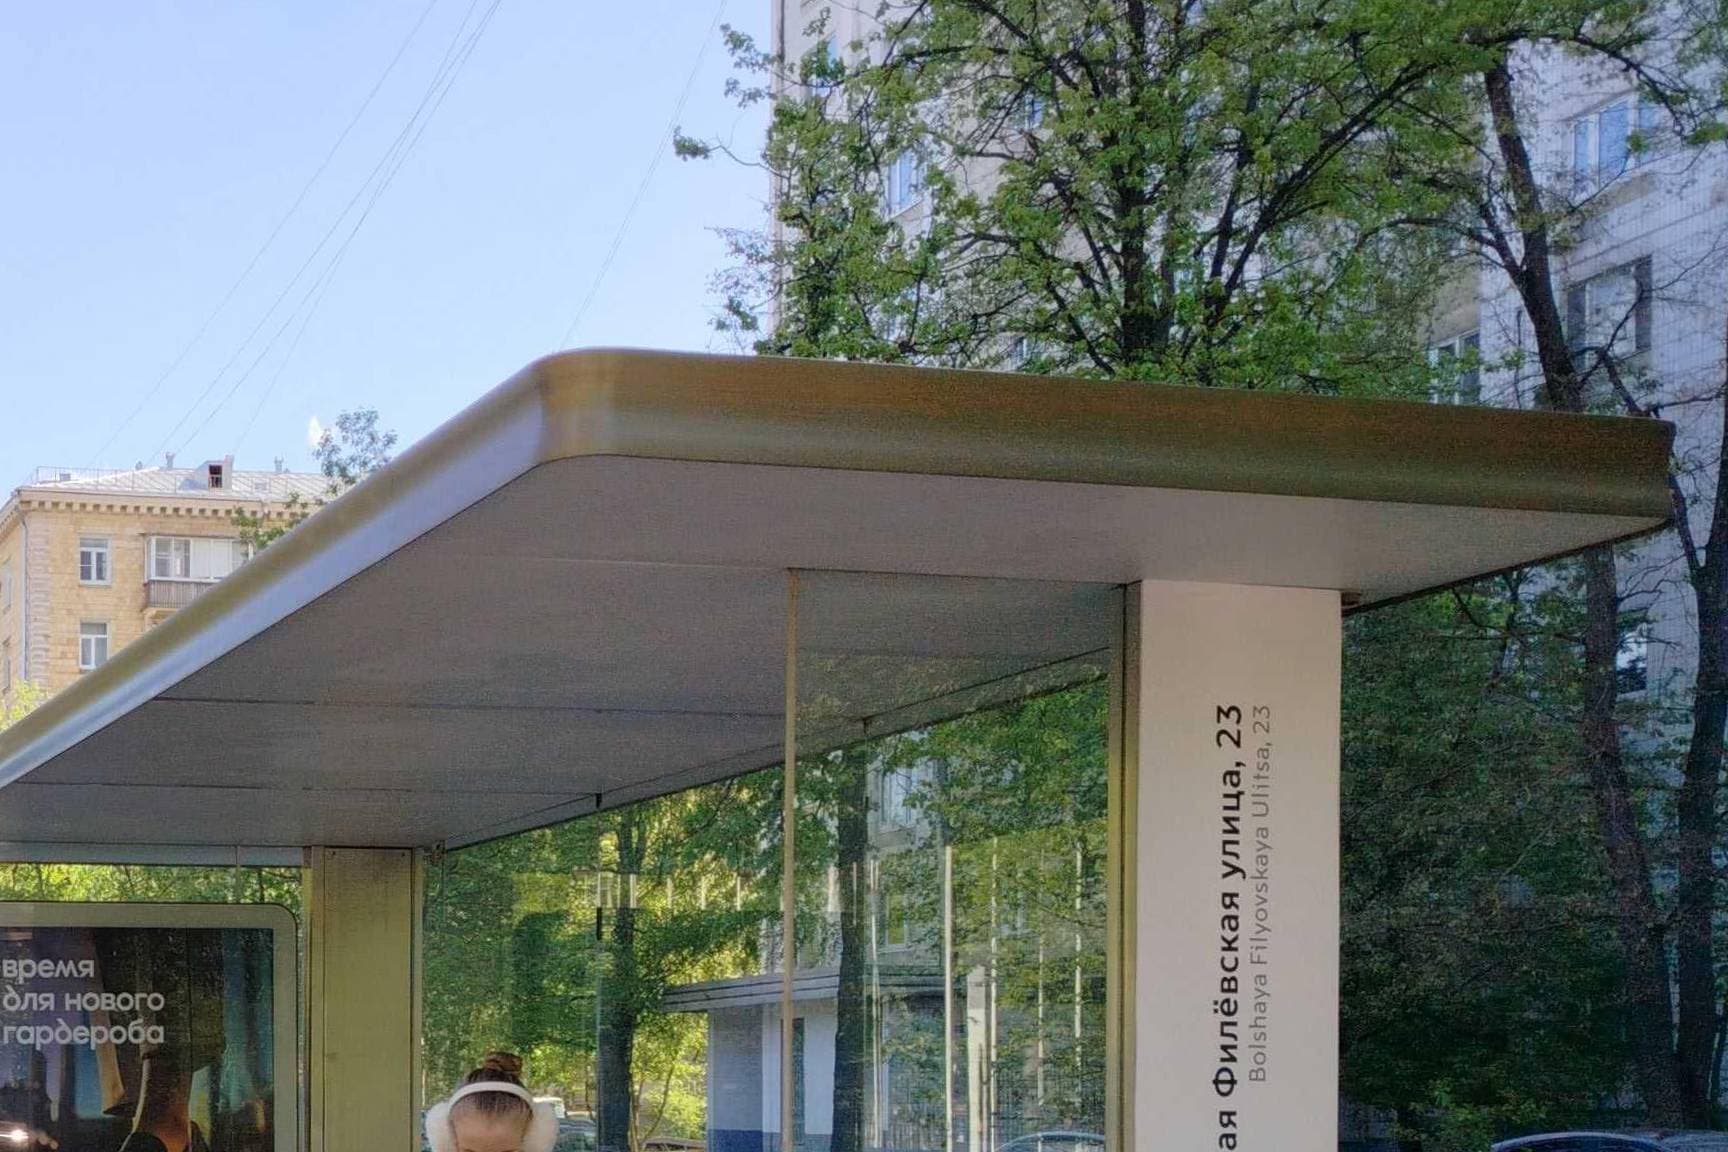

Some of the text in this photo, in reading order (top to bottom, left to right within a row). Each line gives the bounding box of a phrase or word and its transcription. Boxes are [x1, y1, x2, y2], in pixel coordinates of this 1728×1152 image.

[1215, 705, 1242, 749] 23
[1221, 761, 1247, 880] улица,
[1247, 704, 1274, 1083] Bolshaya Filyovskaya Ulitsa, 23
[2, 958, 95, 984] время
[2, 985, 165, 1012] для нового
[1213, 892, 1240, 1098] Филёвская
[3, 1018, 165, 1051] гардероба
